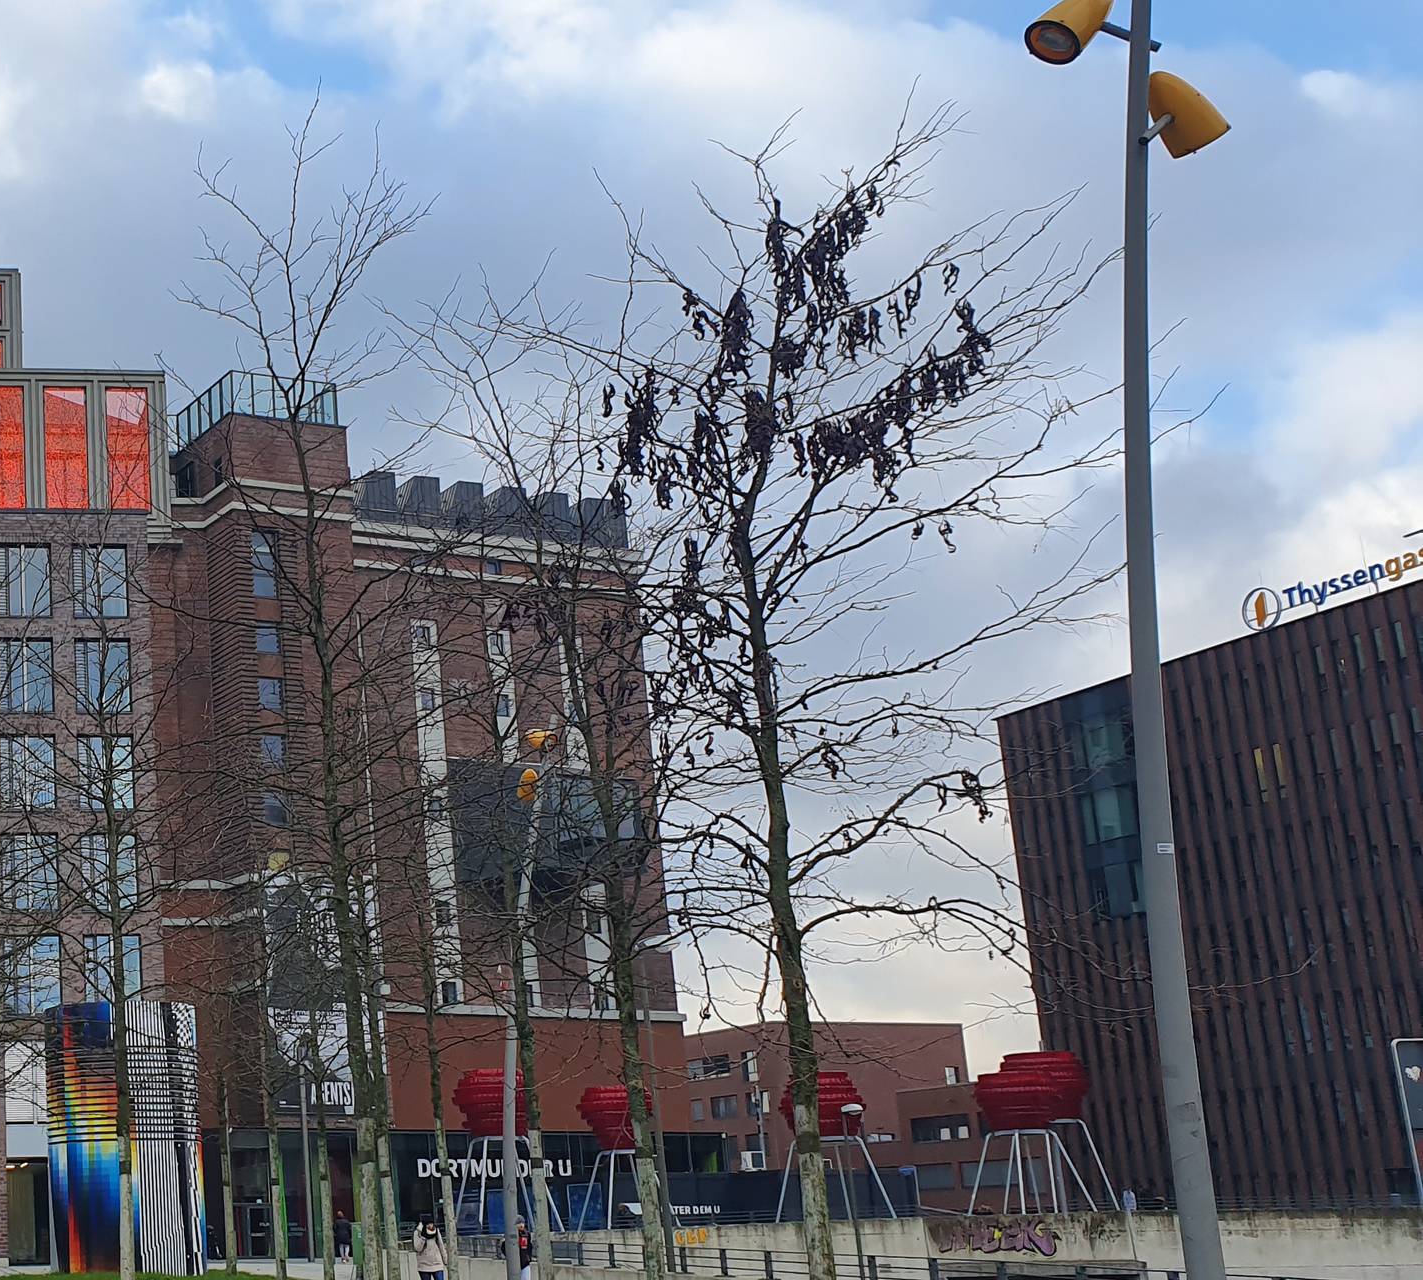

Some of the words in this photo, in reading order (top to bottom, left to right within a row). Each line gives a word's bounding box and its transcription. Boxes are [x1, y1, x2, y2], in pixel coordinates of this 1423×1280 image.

[310, 1081, 352, 1105] AENTS
[417, 1158, 554, 1178] DORTMUDR
[558, 1159, 572, 1177] U
[692, 1205, 712, 1214] DEM
[714, 1205, 721, 1214] U
